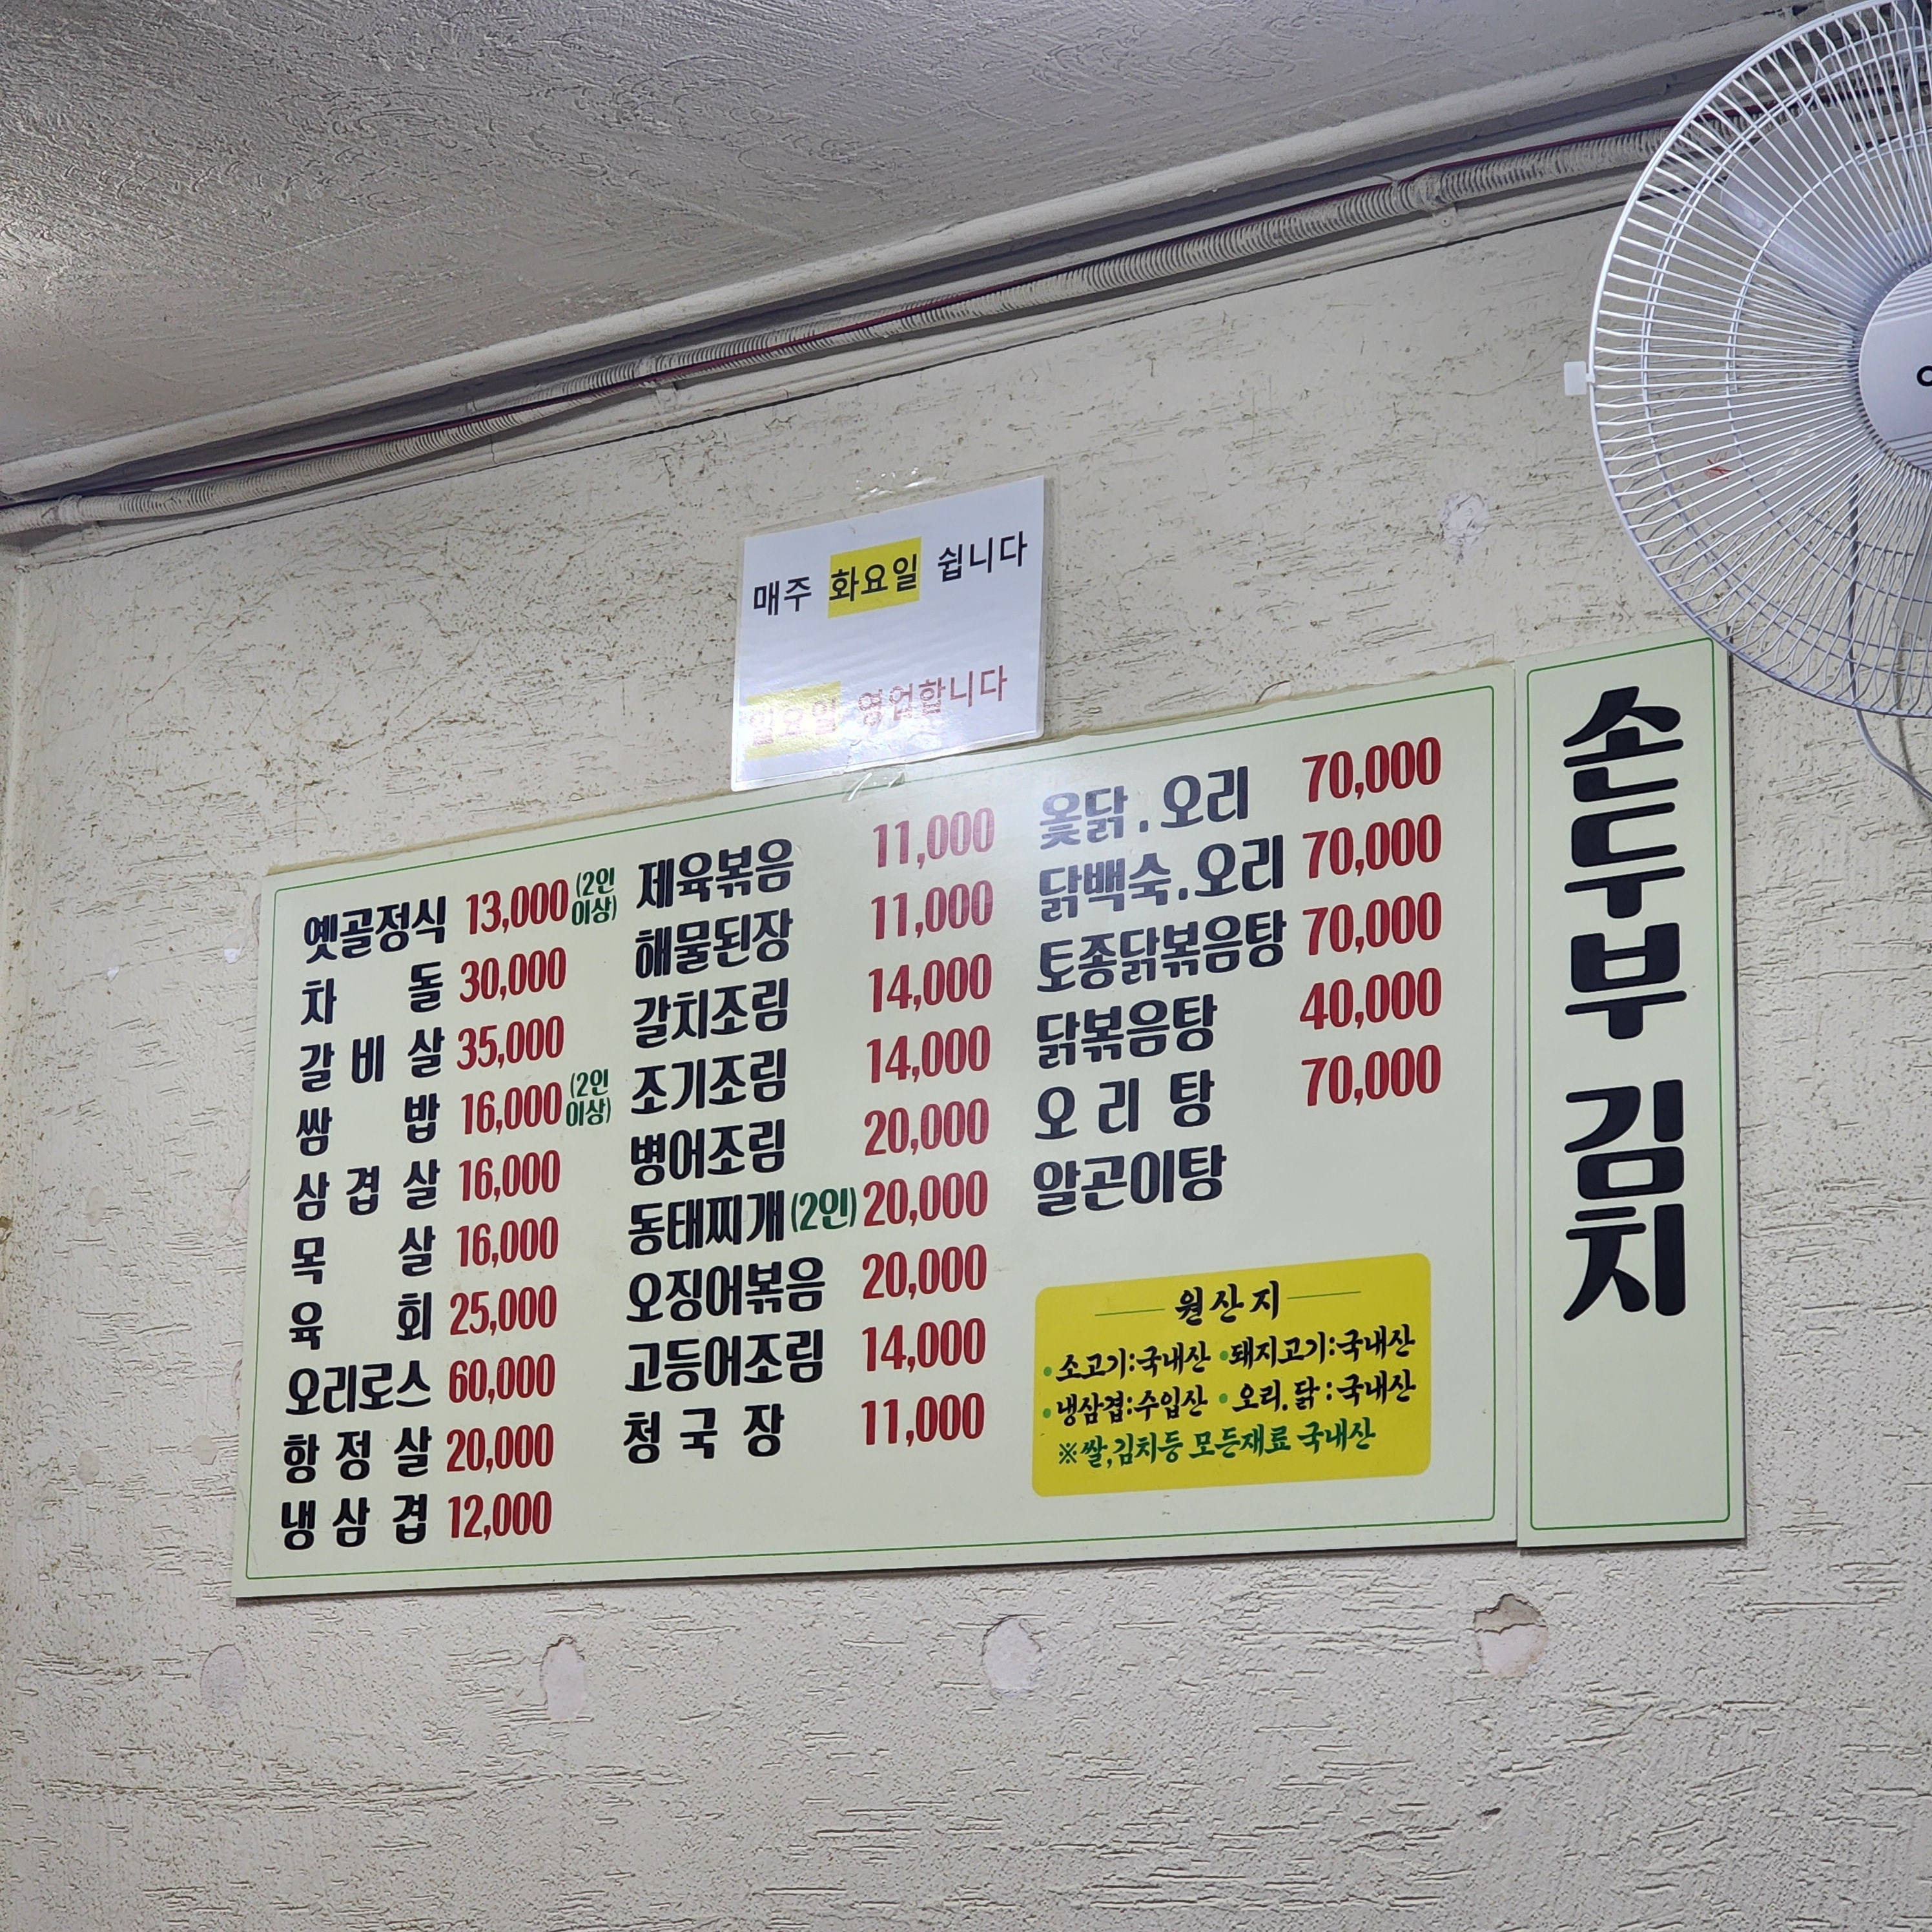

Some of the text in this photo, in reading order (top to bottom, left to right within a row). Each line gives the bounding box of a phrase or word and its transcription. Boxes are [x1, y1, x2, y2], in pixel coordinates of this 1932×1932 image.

[753, 530, 1028, 616] 매주 화요일 쉽니다
[1301, 736, 1441, 803] 70,000
[635, 807, 994, 909] 제육볶음 11,000
[1302, 814, 1442, 879] 70,000
[303, 895, 446, 965] 옛골정식
[466, 879, 569, 936] 13,000
[635, 879, 994, 979] 해물된장 11,000
[1036, 892, 1442, 992] 토종닭볶음탕 70,000
[459, 947, 567, 1003] 30,000
[633, 953, 992, 1049] 갈치조림 14,000
[1562, 685, 1688, 1322] 손두부 김치
[456, 1015, 564, 1071] 35,000
[1036, 967, 1442, 1070] 닭볶음탕 40,000
[630, 1025, 991, 1115] 조기조림 14,000
[1300, 1044, 1441, 1107] 70,000
[460, 1082, 562, 1135] 16,000
[458, 1149, 560, 1202] 16,000
[630, 1098, 989, 1187] 병어조림 20,000
[863, 1170, 989, 1227] 20,000
[1033, 1144, 1228, 1217] 알곤이탕
[456, 1216, 559, 1269] 16,000
[449, 1284, 557, 1337] 25,000
[626, 1244, 987, 1323] 오징어볶음 20,000
[285, 1353, 556, 1415] 오리로스 60,000
[624, 1317, 986, 1392] 고등어조림 14,000
[446, 1423, 554, 1474] 20,000
[861, 1392, 985, 1448] 11,000
[1297, 1416, 1376, 1454] 국내산
[447, 1490, 552, 1541] 12,000
